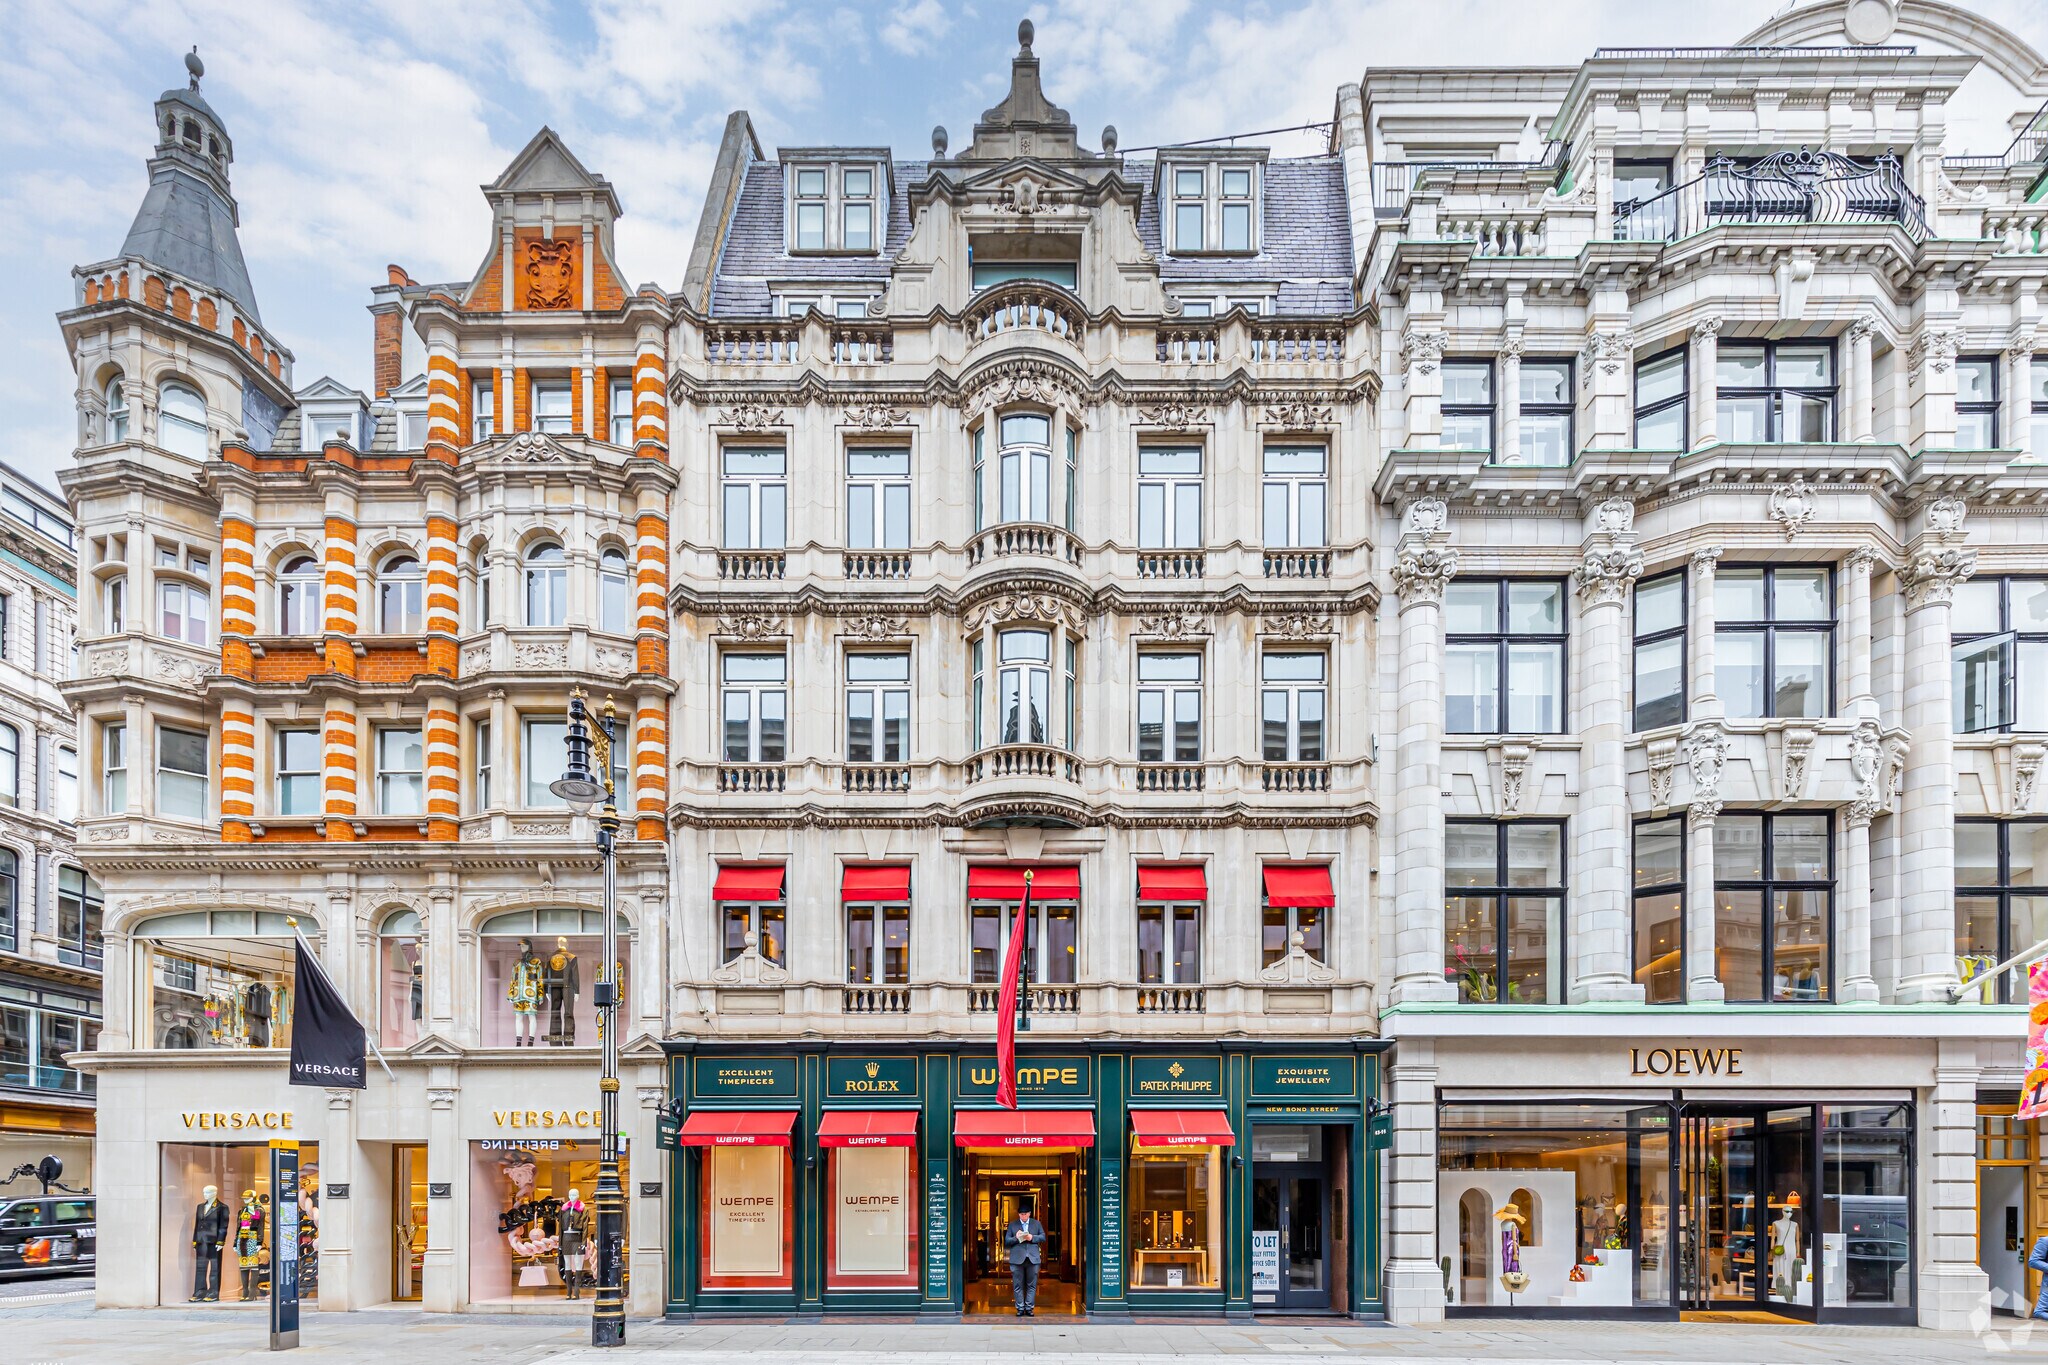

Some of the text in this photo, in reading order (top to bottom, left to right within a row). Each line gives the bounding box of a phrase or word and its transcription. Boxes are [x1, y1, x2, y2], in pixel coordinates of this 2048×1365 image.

[1630, 1049, 1743, 1076] LOEWE
[295, 1064, 359, 1077] VERSACE
[971, 1068, 1078, 1085] WMPE
[845, 1081, 899, 1091] ROLEX
[1140, 1081, 1212, 1091] PATEK PHILIPPE
[182, 1112, 293, 1130] VERSACE
[493, 1110, 602, 1128] VERSACE
[720, 1197, 773, 1206] WEMPE
[845, 1196, 899, 1205] WEMPE
[1253, 1236, 1277, 1247] O LET
